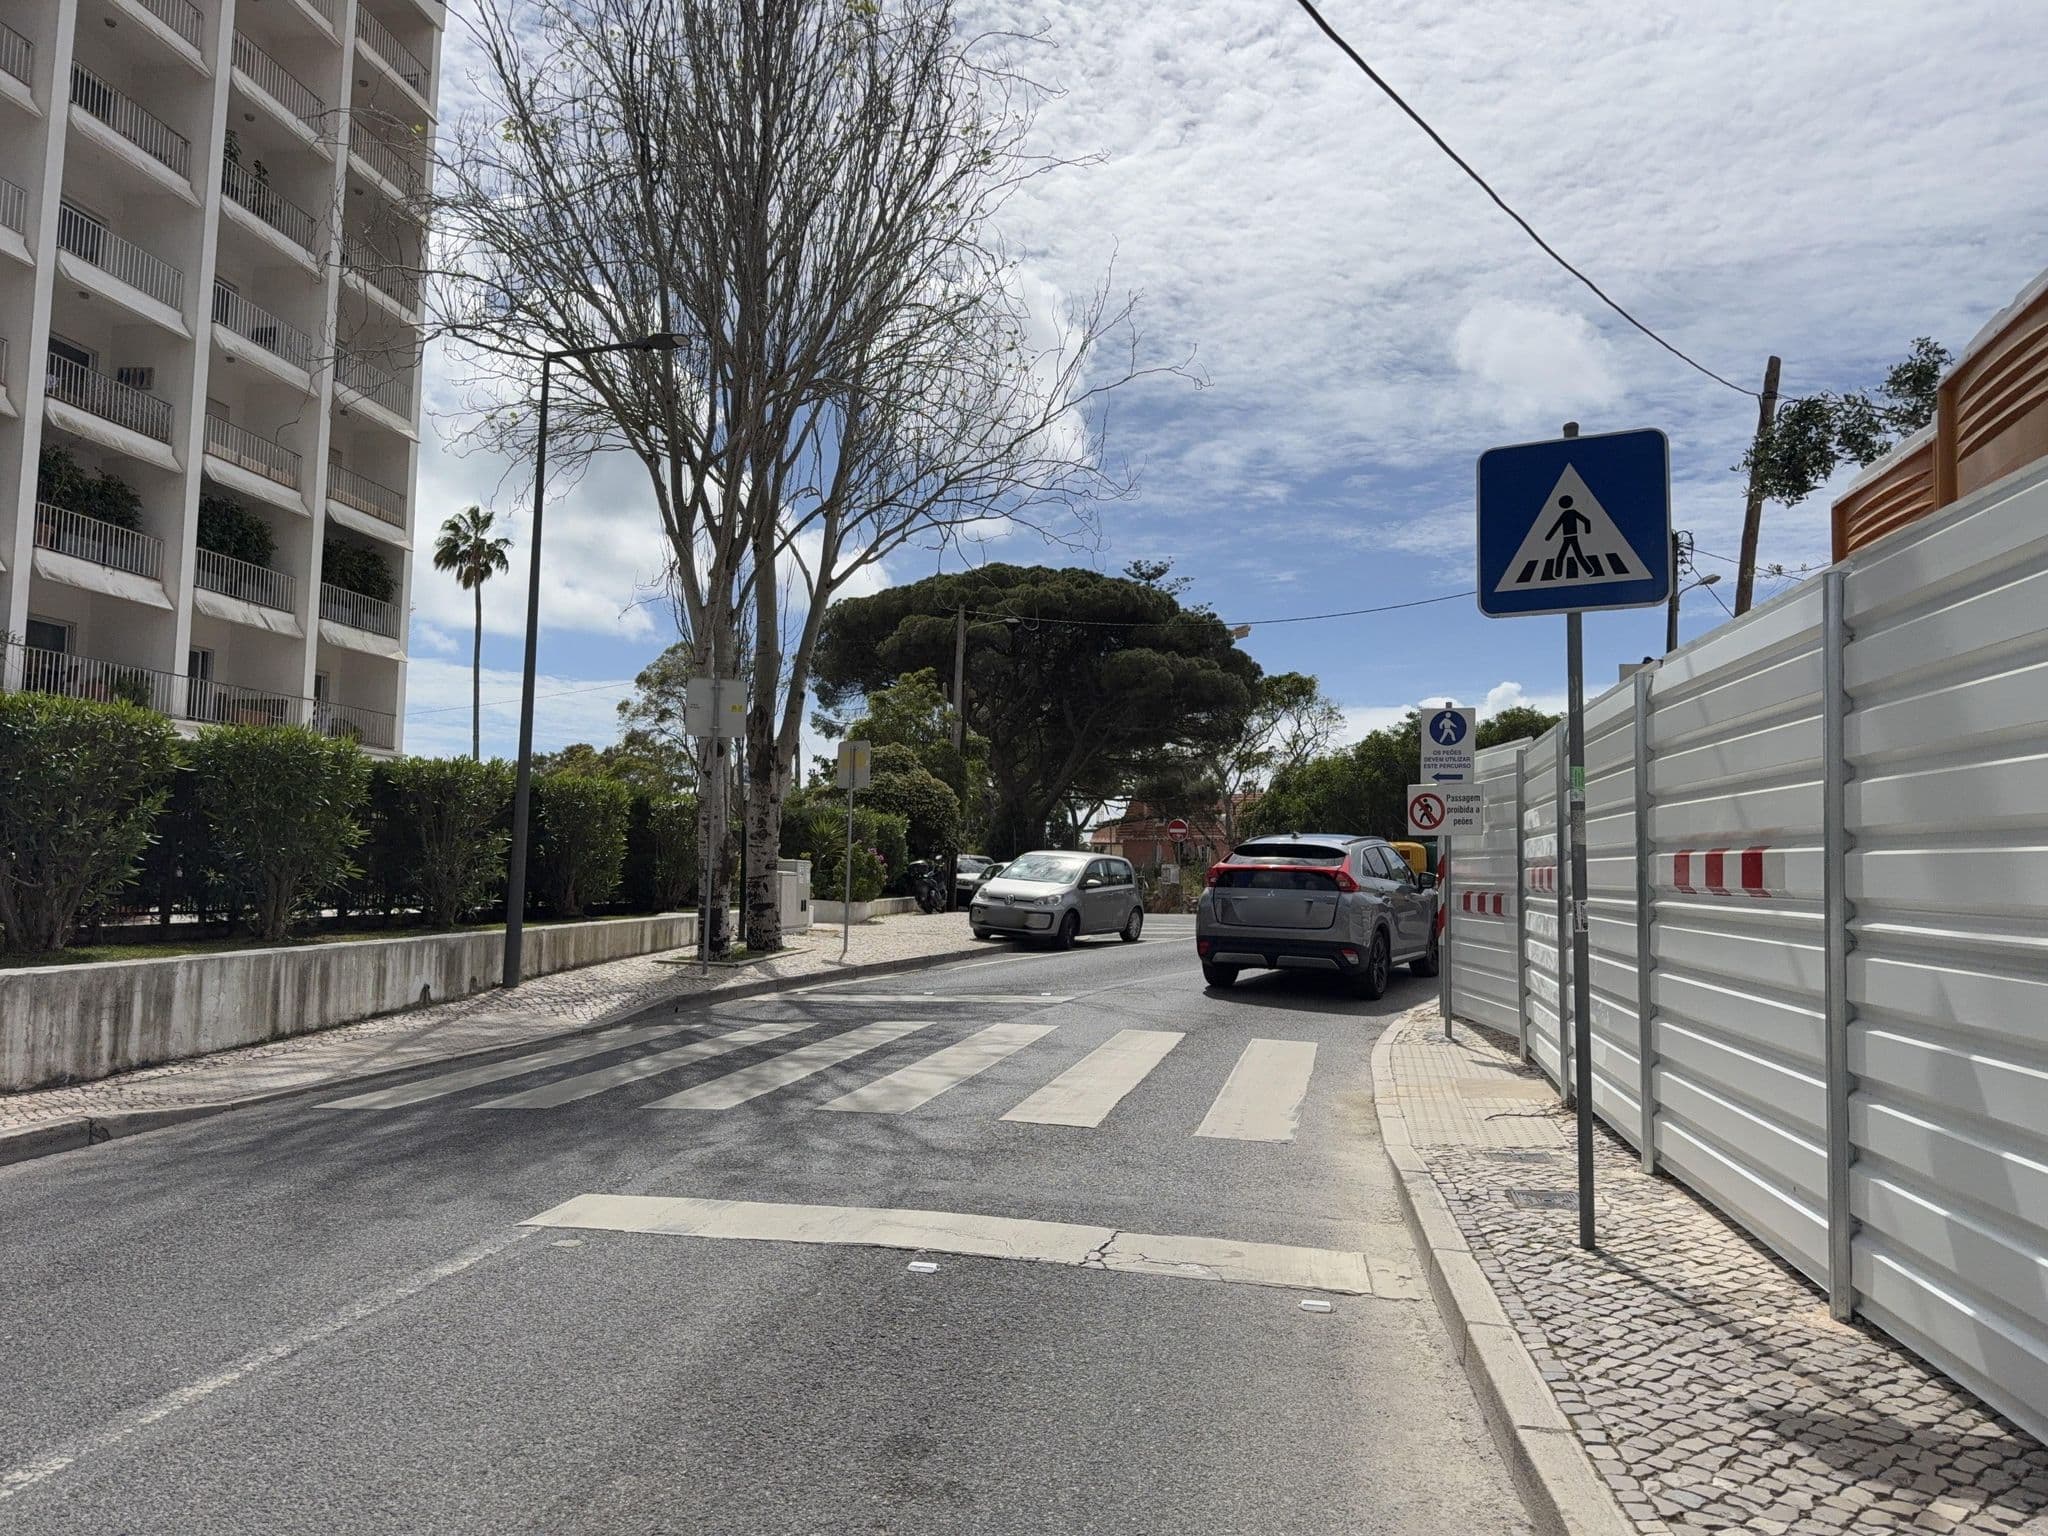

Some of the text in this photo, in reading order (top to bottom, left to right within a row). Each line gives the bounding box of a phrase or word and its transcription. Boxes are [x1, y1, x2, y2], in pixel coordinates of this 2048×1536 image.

[1446, 794, 1480, 803] Passagem
[1446, 807, 1474, 815] proibida
[1453, 817, 1473, 826] peões
